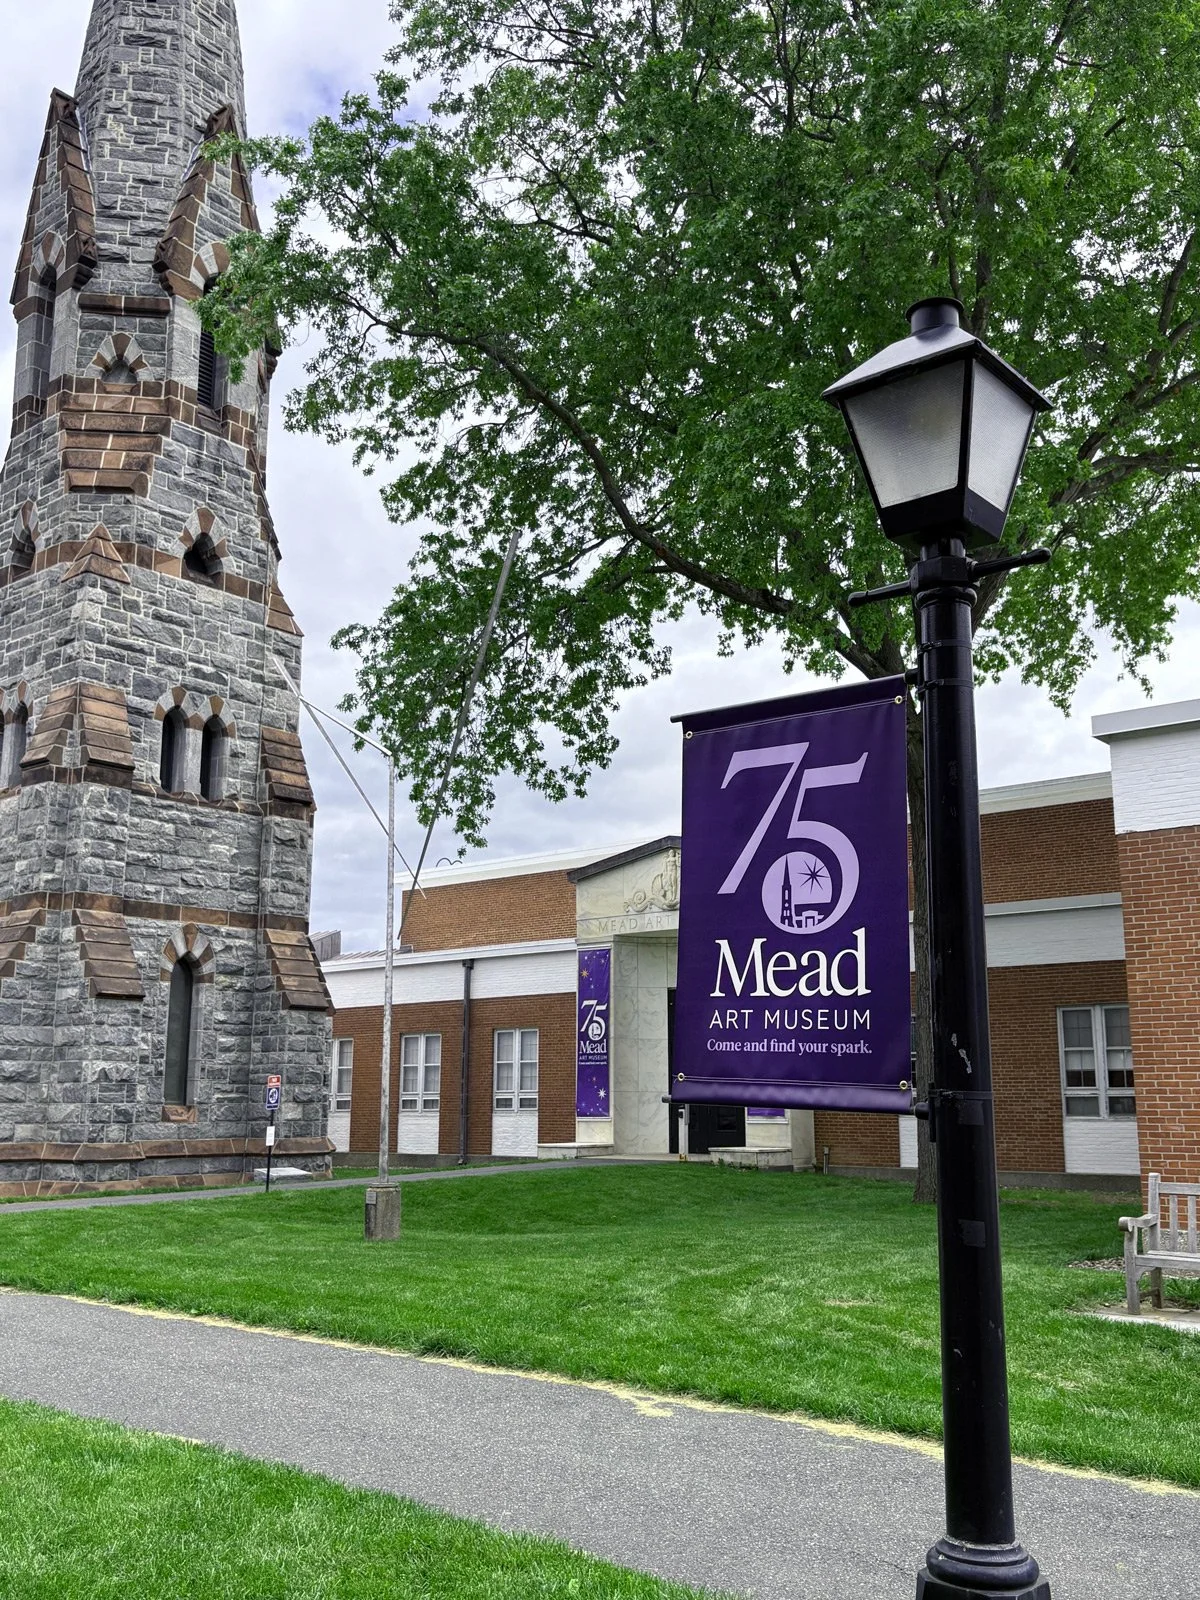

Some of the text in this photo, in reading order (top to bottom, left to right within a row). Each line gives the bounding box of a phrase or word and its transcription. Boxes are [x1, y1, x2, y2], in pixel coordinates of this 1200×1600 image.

[717, 741, 869, 935] 75
[598, 914, 672, 933] MEAD ART
[710, 927, 871, 998] Mead
[580, 1000, 607, 1041] 75
[709, 1009, 871, 1031] ART MUSEUM
[579, 1038, 607, 1053] Mead
[706, 1038, 873, 1057] Come and find your spark.
